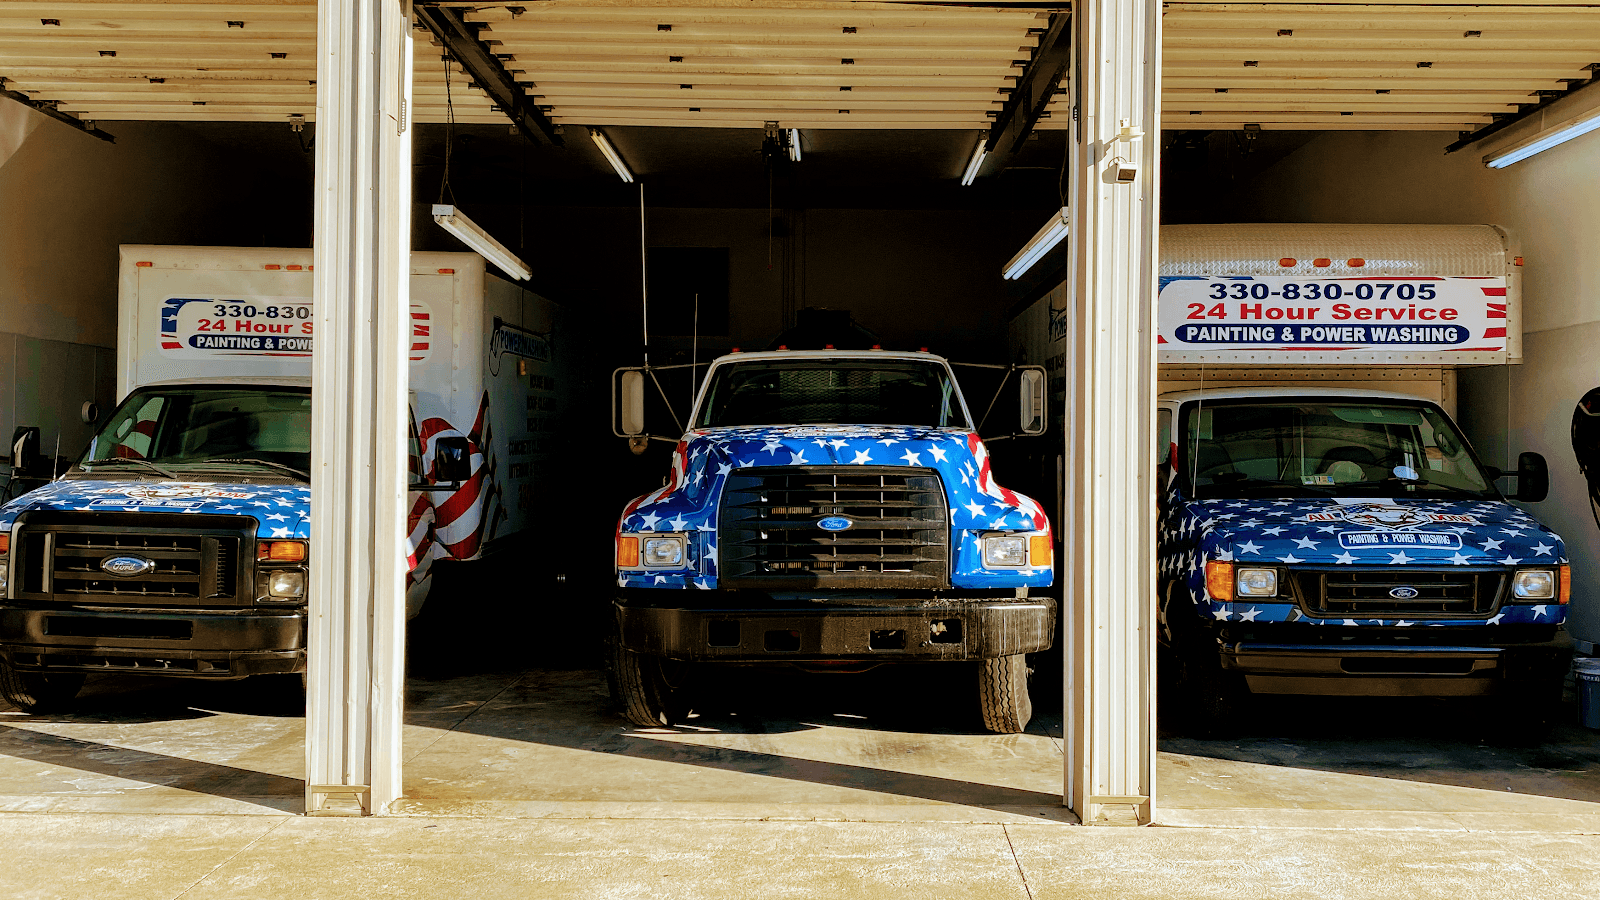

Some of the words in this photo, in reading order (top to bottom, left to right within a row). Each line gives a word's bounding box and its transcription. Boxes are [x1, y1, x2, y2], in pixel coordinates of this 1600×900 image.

[1208, 282, 1437, 300] 330-830-0705
[1186, 302, 1228, 320] 24
[1239, 302, 1321, 320] Hour
[1331, 302, 1459, 320] Service
[197, 318, 227, 332] 24
[235, 319, 294, 333] Hour
[1186, 326, 1276, 342] PAINTING
[1281, 327, 1295, 342] &
[1300, 327, 1366, 342] POWER
[1370, 327, 1458, 343] WASHING
[196, 336, 261, 349] PAINTING
[264, 338, 275, 350] &
[1307, 513, 1336, 522] ALL
[1347, 533, 1379, 544] PAINTING
[1382, 534, 1389, 543] &
[1391, 534, 1417, 544] POWER
[1420, 534, 1451, 545] WASHING
[112, 560, 136, 571] Ford
